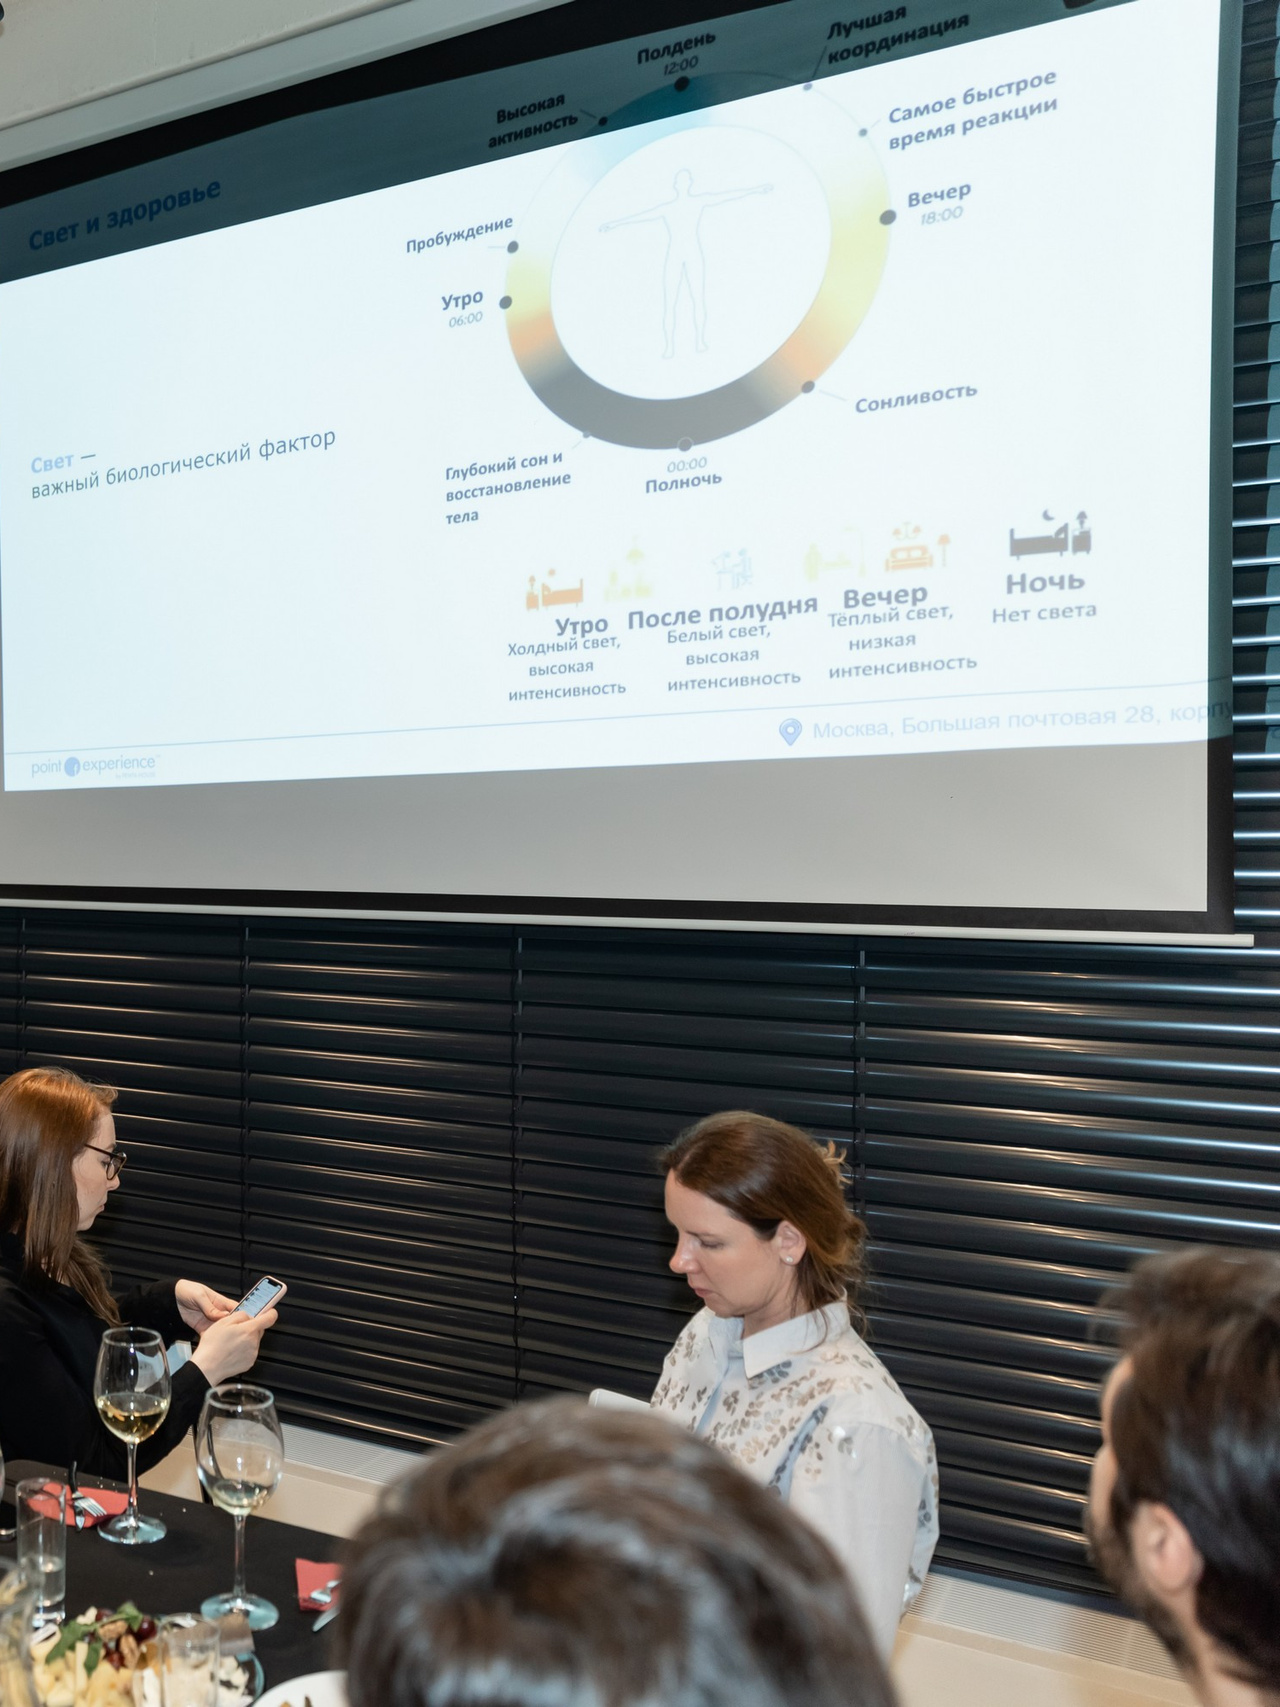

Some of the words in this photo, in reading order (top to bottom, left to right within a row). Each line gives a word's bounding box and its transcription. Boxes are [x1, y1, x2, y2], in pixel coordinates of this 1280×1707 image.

[827, 6, 907, 40] Лучшая
[637, 32, 716, 64] Полдень
[828, 14, 970, 64] координация
[664, 56, 699, 76] 12:00
[497, 94, 565, 124] Высокая
[889, 97, 957, 124] Самое
[962, 71, 1057, 106] быстрое
[488, 113, 578, 148] активность
[889, 123, 956, 150] время
[962, 98, 1058, 135] реакции
[908, 183, 972, 208] Вечер
[29, 223, 79, 250] Свет
[86, 217, 100, 234] и
[107, 181, 221, 228] здоровье
[921, 205, 964, 225] 18:00
[406, 218, 513, 253] Пробуждение
[441, 291, 484, 310] Утро
[449, 311, 483, 328] 06:00
[855, 386, 978, 413] Сонливость
[31, 453, 74, 474] Свет
[31, 471, 99, 499] важный
[106, 443, 251, 485] биологический
[259, 430, 336, 461] фактор
[446, 457, 516, 481] Глубокий
[521, 454, 549, 469] сон
[553, 452, 563, 463] и
[667, 456, 708, 473] 00:00
[446, 473, 572, 502] восстановление
[645, 473, 723, 494] Полночь
[446, 510, 479, 525] тела
[1006, 573, 1086, 595] Ночь
[843, 586, 928, 609] Вечер
[628, 608, 701, 630] После
[709, 597, 818, 623] полудня
[828, 607, 900, 628] Тёплый
[906, 605, 953, 621] свет,
[992, 608, 1031, 623] Нет
[1037, 604, 1097, 621] света
[555, 617, 608, 639] Утро
[667, 624, 724, 644] Белый
[728, 624, 771, 639] свет,
[508, 637, 578, 657] Холдный
[582, 635, 621, 650] свет,
[849, 633, 916, 651] низкая
[529, 661, 594, 677] высокая
[685, 649, 760, 666] высокая
[829, 656, 978, 679] интенсивность
[508, 682, 627, 701] интенсивность
[668, 671, 801, 692] интенсивность
[813, 719, 895, 740] Москва,
[902, 712, 1001, 734] Большая
[1008, 707, 1117, 729] почтовая
[1124, 704, 1162, 725] 28,
[31, 759, 62, 778] point
[82, 755, 156, 775] experience
